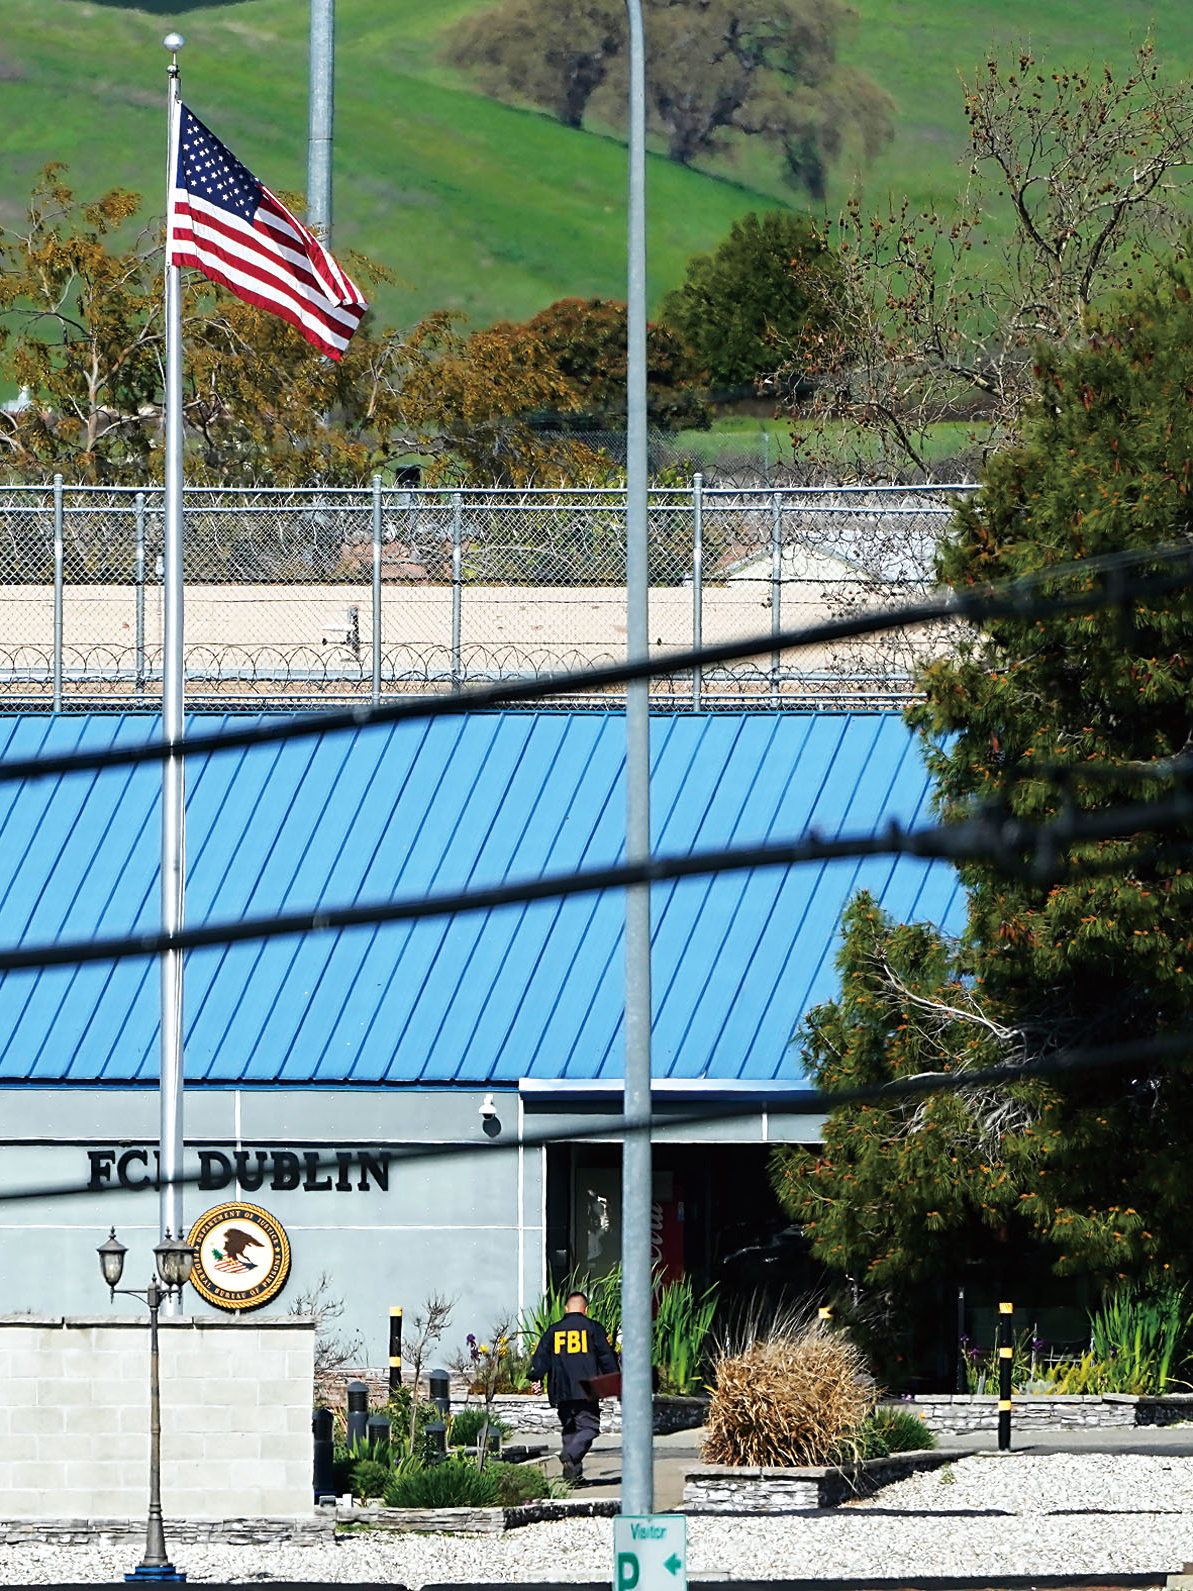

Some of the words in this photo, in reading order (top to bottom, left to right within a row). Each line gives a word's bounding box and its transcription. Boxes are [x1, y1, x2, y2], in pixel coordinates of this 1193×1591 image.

[197, 1150, 392, 1192] DUBLIN
[196, 1210, 241, 1243] DEPARTMENT
[244, 1211, 254, 1219] OF
[257, 1218, 279, 1244] JUSTICE
[193, 1253, 211, 1289] FEDERAL
[214, 1287, 247, 1299] BUREAU
[250, 1287, 260, 1296] OF
[262, 1254, 281, 1288] PRISONS
[554, 1329, 588, 1355] FBI
[630, 1523, 667, 1540] Visitor
[618, 1552, 640, 1591] P
